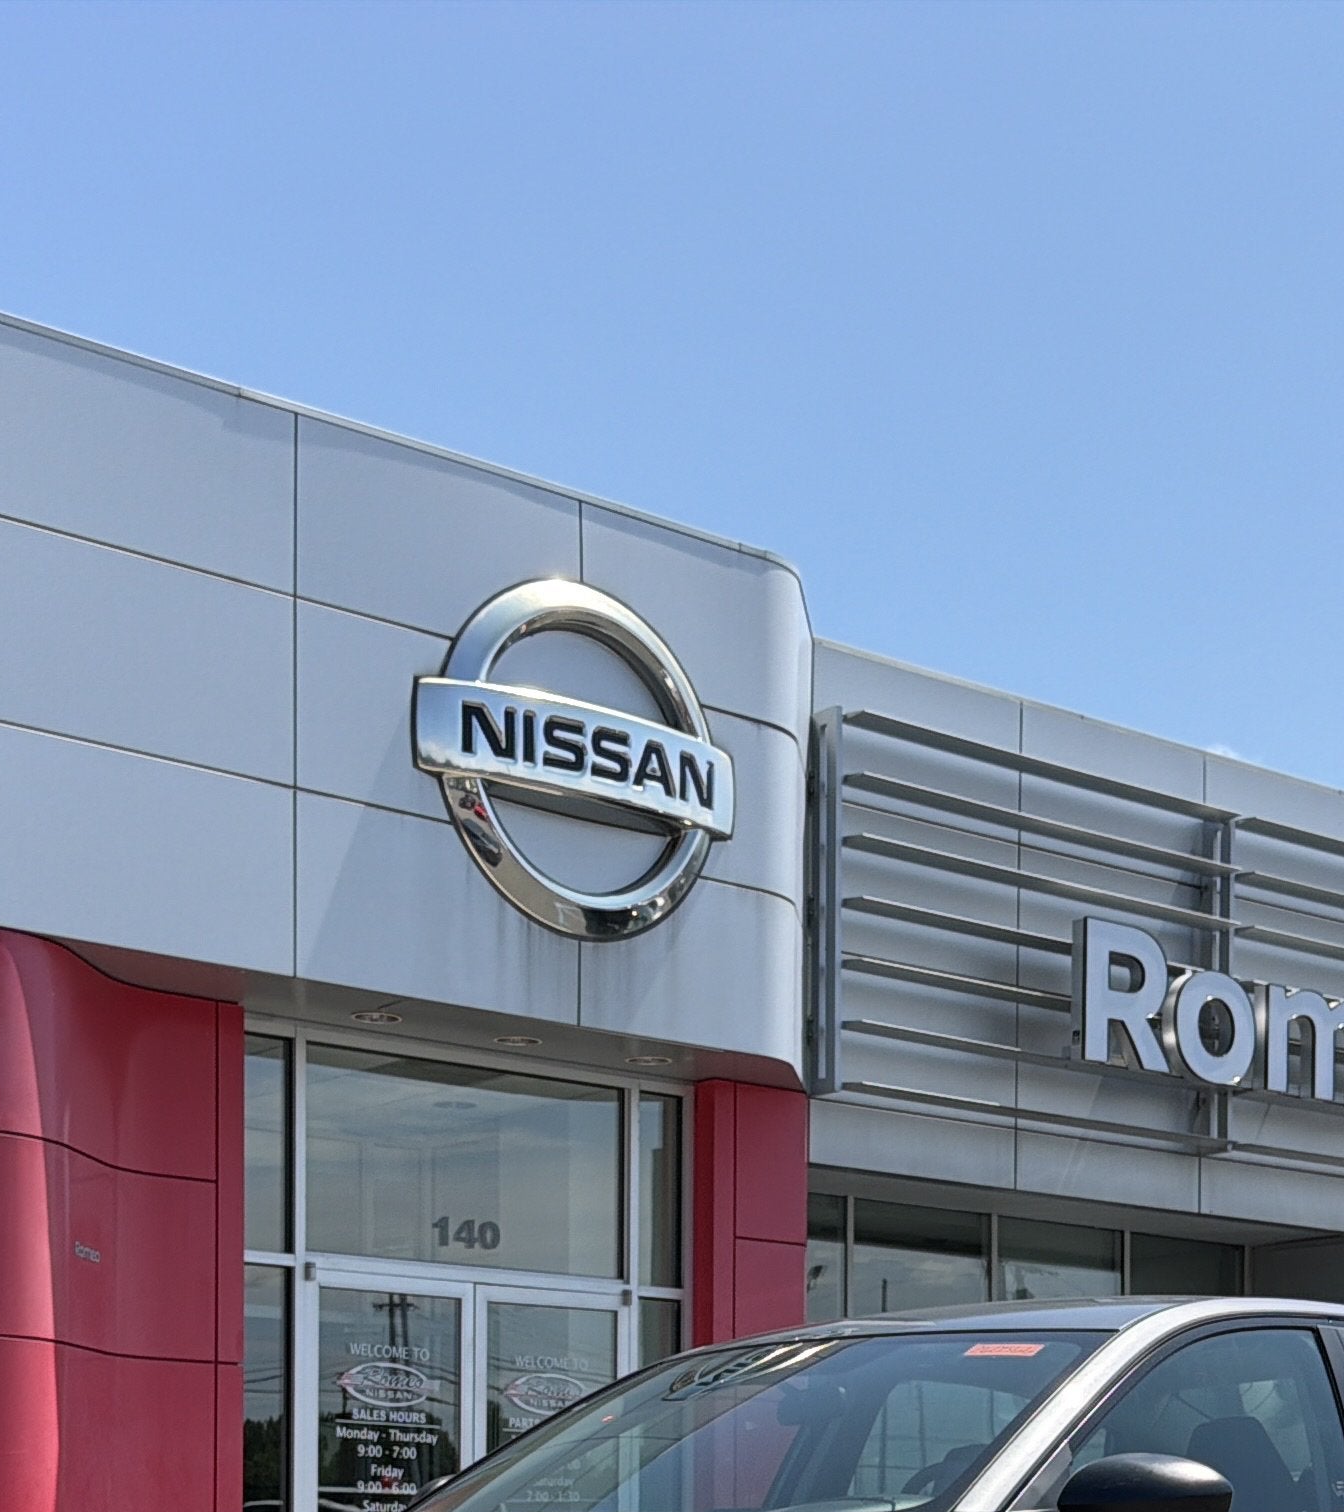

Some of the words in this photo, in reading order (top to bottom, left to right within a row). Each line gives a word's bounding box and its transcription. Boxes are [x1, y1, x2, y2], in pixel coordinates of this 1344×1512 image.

[461, 700, 715, 811] NISSAN
[432, 1216, 500, 1250] 140
[350, 1342, 409, 1360] WELCOME
[413, 1347, 430, 1361] TO
[515, 1355, 568, 1370] WELCOME
[573, 1358, 588, 1371] TO
[363, 1367, 422, 1389] Romeo
[365, 1388, 414, 1400] NISSAN
[352, 1408, 386, 1421] SALES
[389, 1411, 426, 1423] HOURS
[336, 1425, 380, 1442] Monday
[388, 1429, 438, 1445] Thursday
[357, 1444, 383, 1458] 9:00
[392, 1446, 417, 1459] 7:00
[370, 1464, 404, 1480] Friday
[357, 1480, 383, 1493] 9:00
[392, 1482, 417, 1495] 6:00
